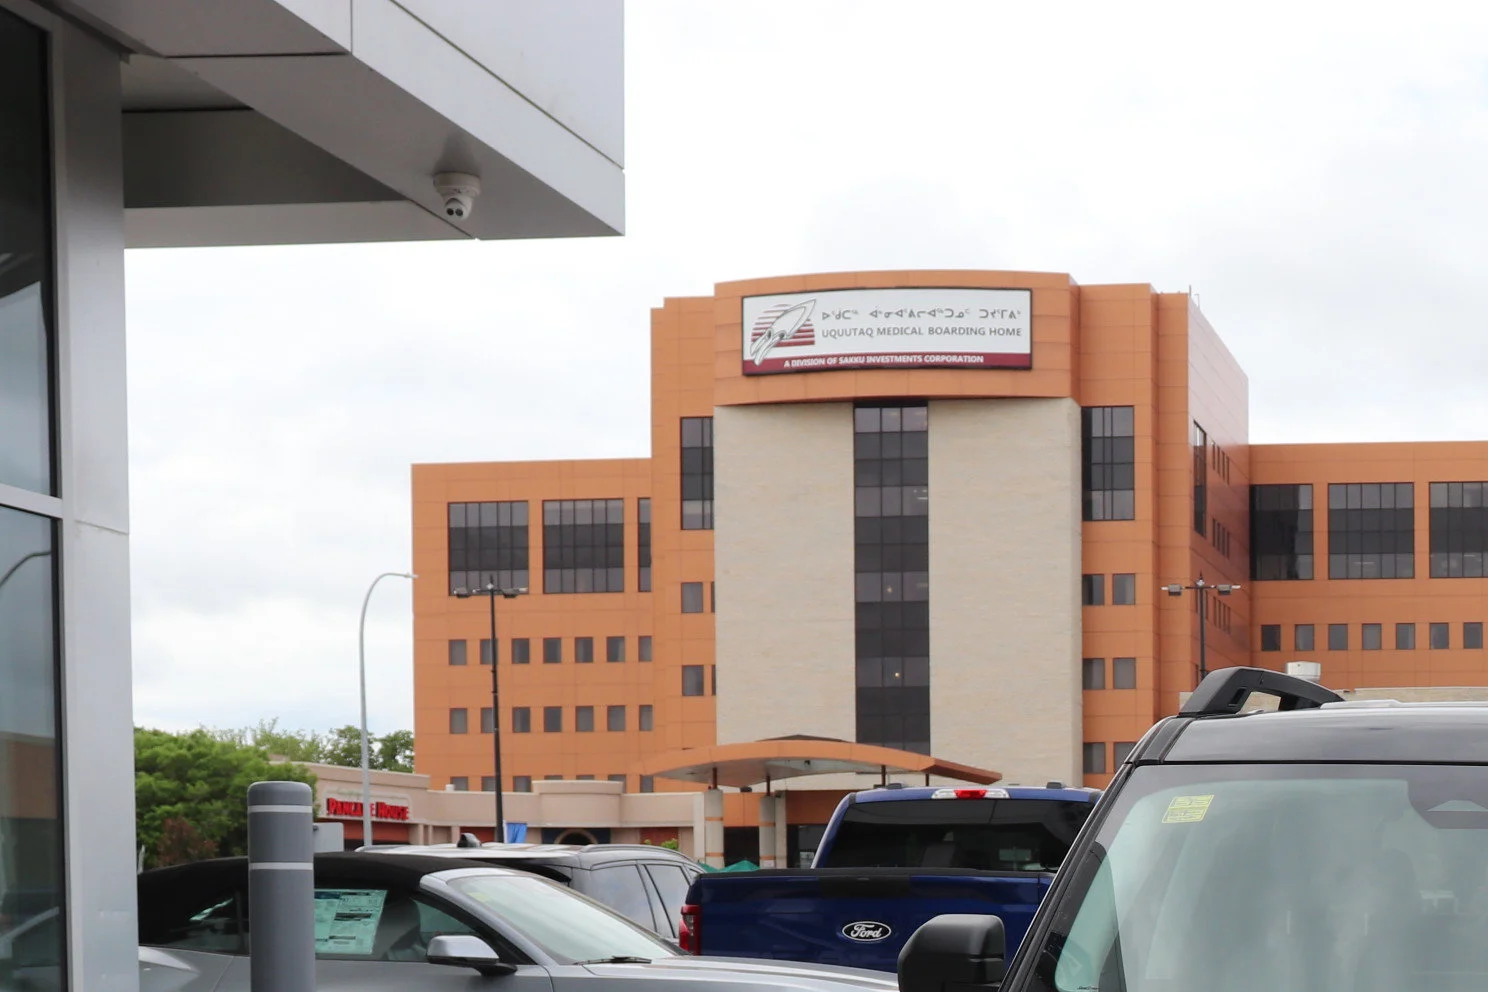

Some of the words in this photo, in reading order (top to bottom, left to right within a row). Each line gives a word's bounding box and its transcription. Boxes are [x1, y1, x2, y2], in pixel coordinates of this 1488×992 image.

[821, 327, 874, 339] UQUUTAQ
[876, 327, 924, 336] MEDICAL
[928, 326, 986, 336] BOARDING
[989, 327, 1022, 337] HOME
[784, 360, 791, 368] A
[791, 358, 826, 367] DIVISION
[827, 357, 837, 365] OF
[838, 356, 866, 365] SAKKU
[866, 355, 923, 364] INVESTMENTS
[923, 354, 984, 363] CORPORATION
[327, 797, 376, 817] PANCAE
[850, 923, 883, 938] Ford
